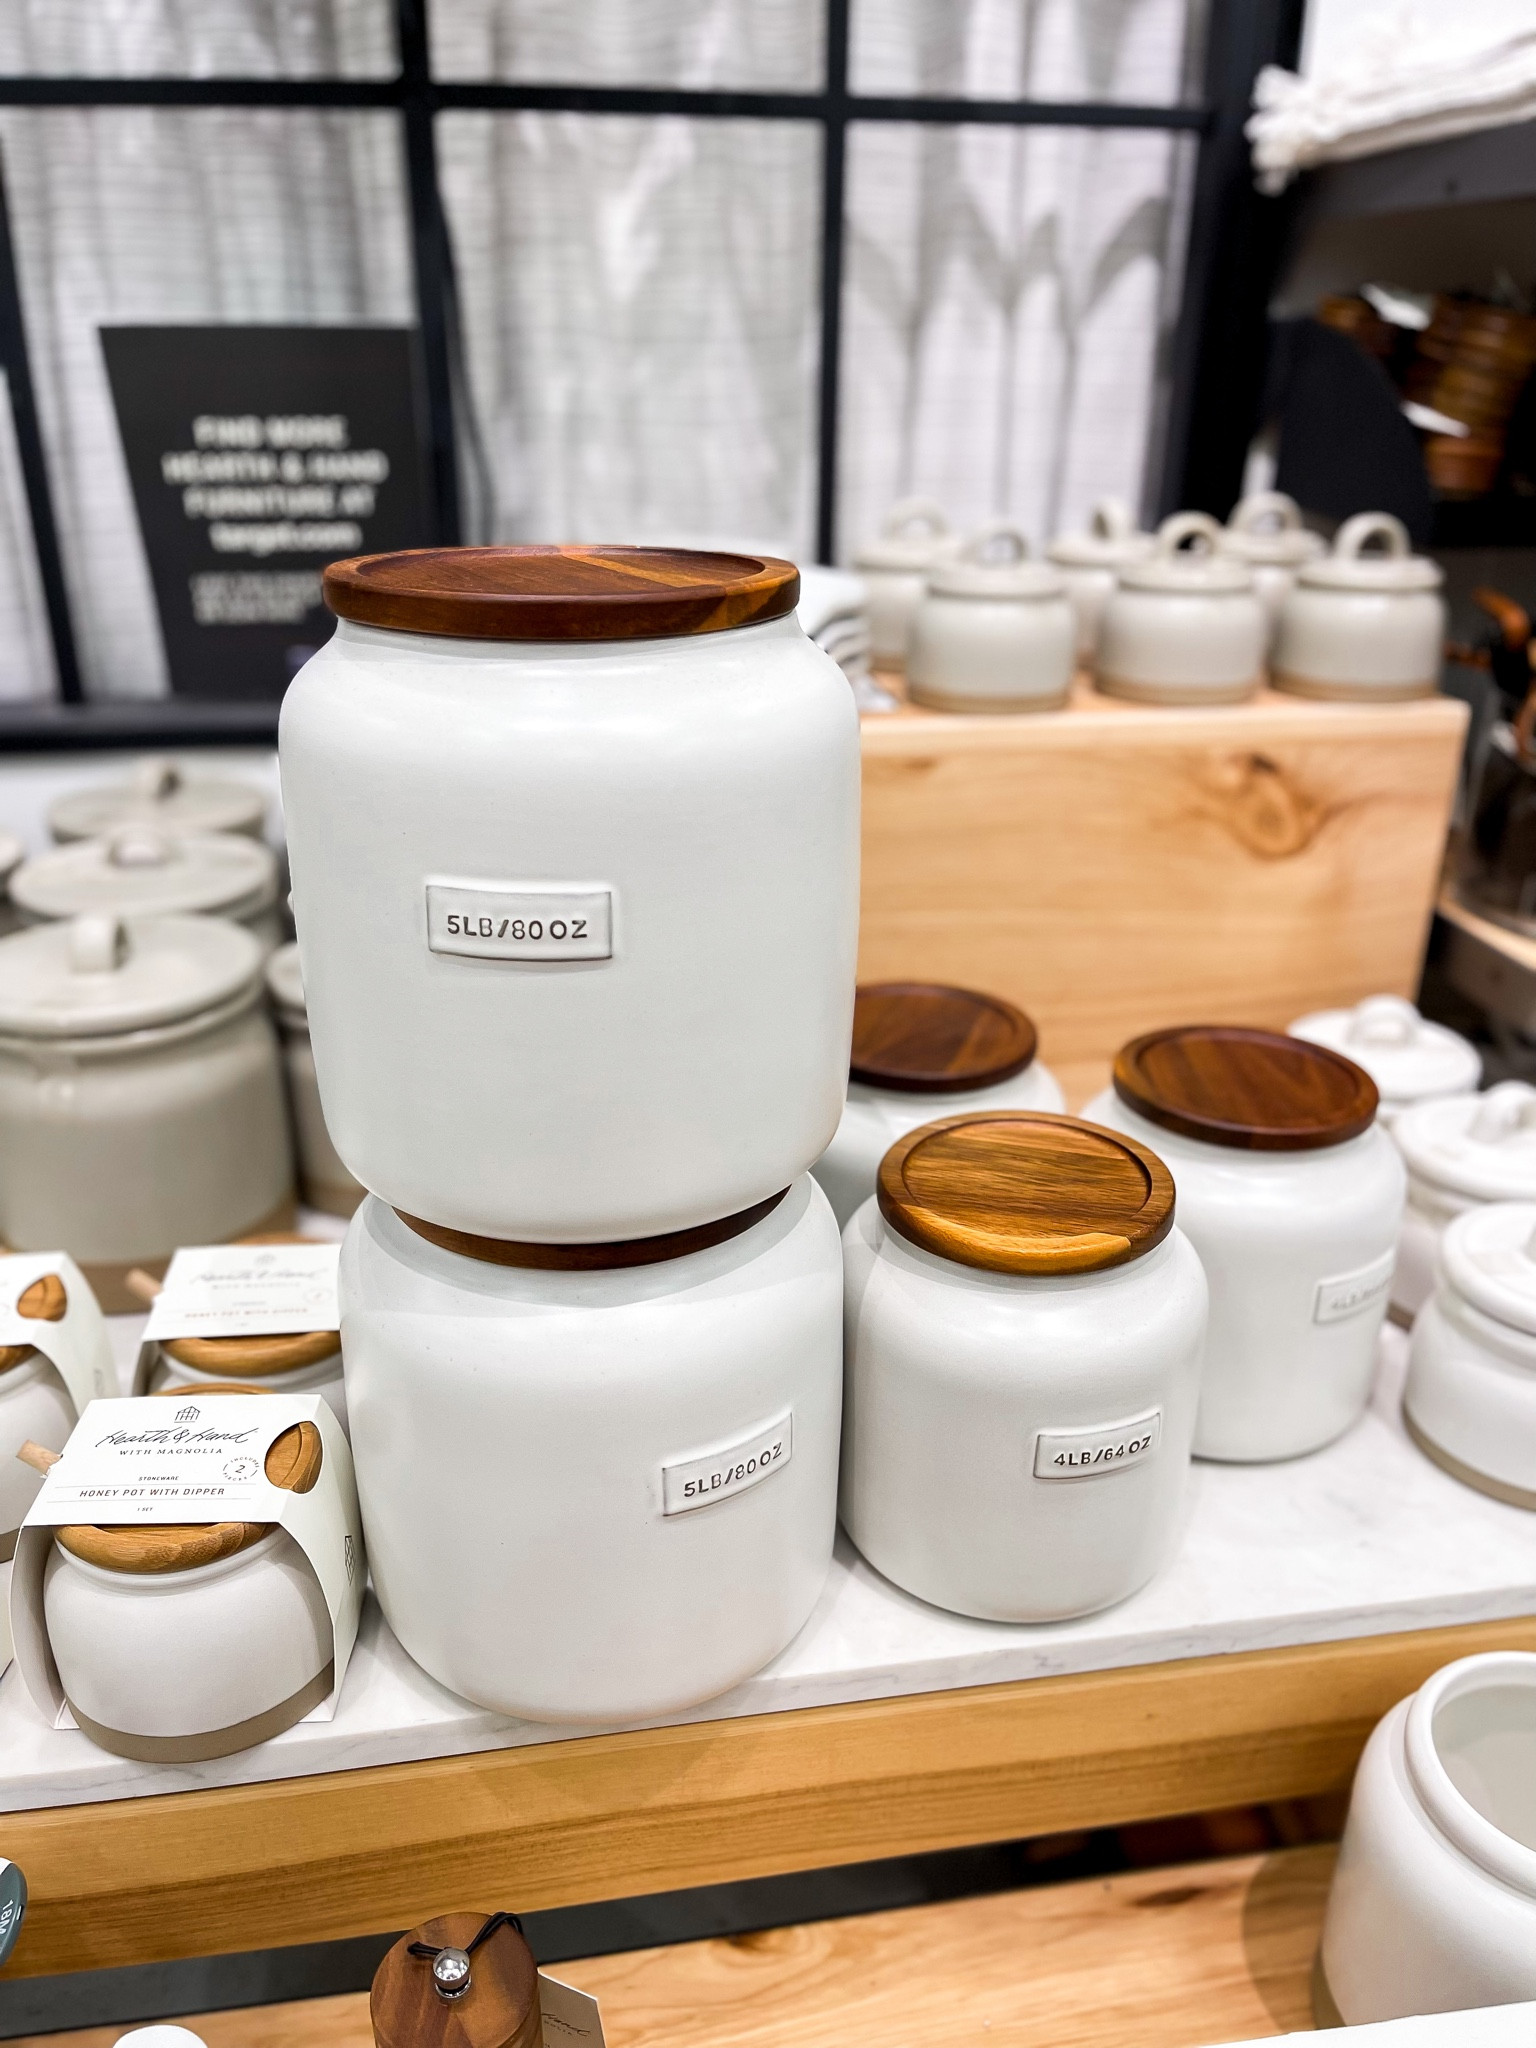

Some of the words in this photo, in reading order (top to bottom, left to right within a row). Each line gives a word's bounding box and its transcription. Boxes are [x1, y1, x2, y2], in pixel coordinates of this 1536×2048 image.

[95, 1425, 182, 1448] Hearth
[173, 1428, 190, 1444] &
[185, 1427, 259, 1444] Hand
[156, 1448, 222, 1456] MAGNOLIA
[234, 1464, 246, 1474] 2
[79, 1489, 119, 1498] HONEY
[122, 1489, 146, 1497] POT
[149, 1488, 179, 1497] WITH
[182, 1487, 225, 1496] DIPPER
